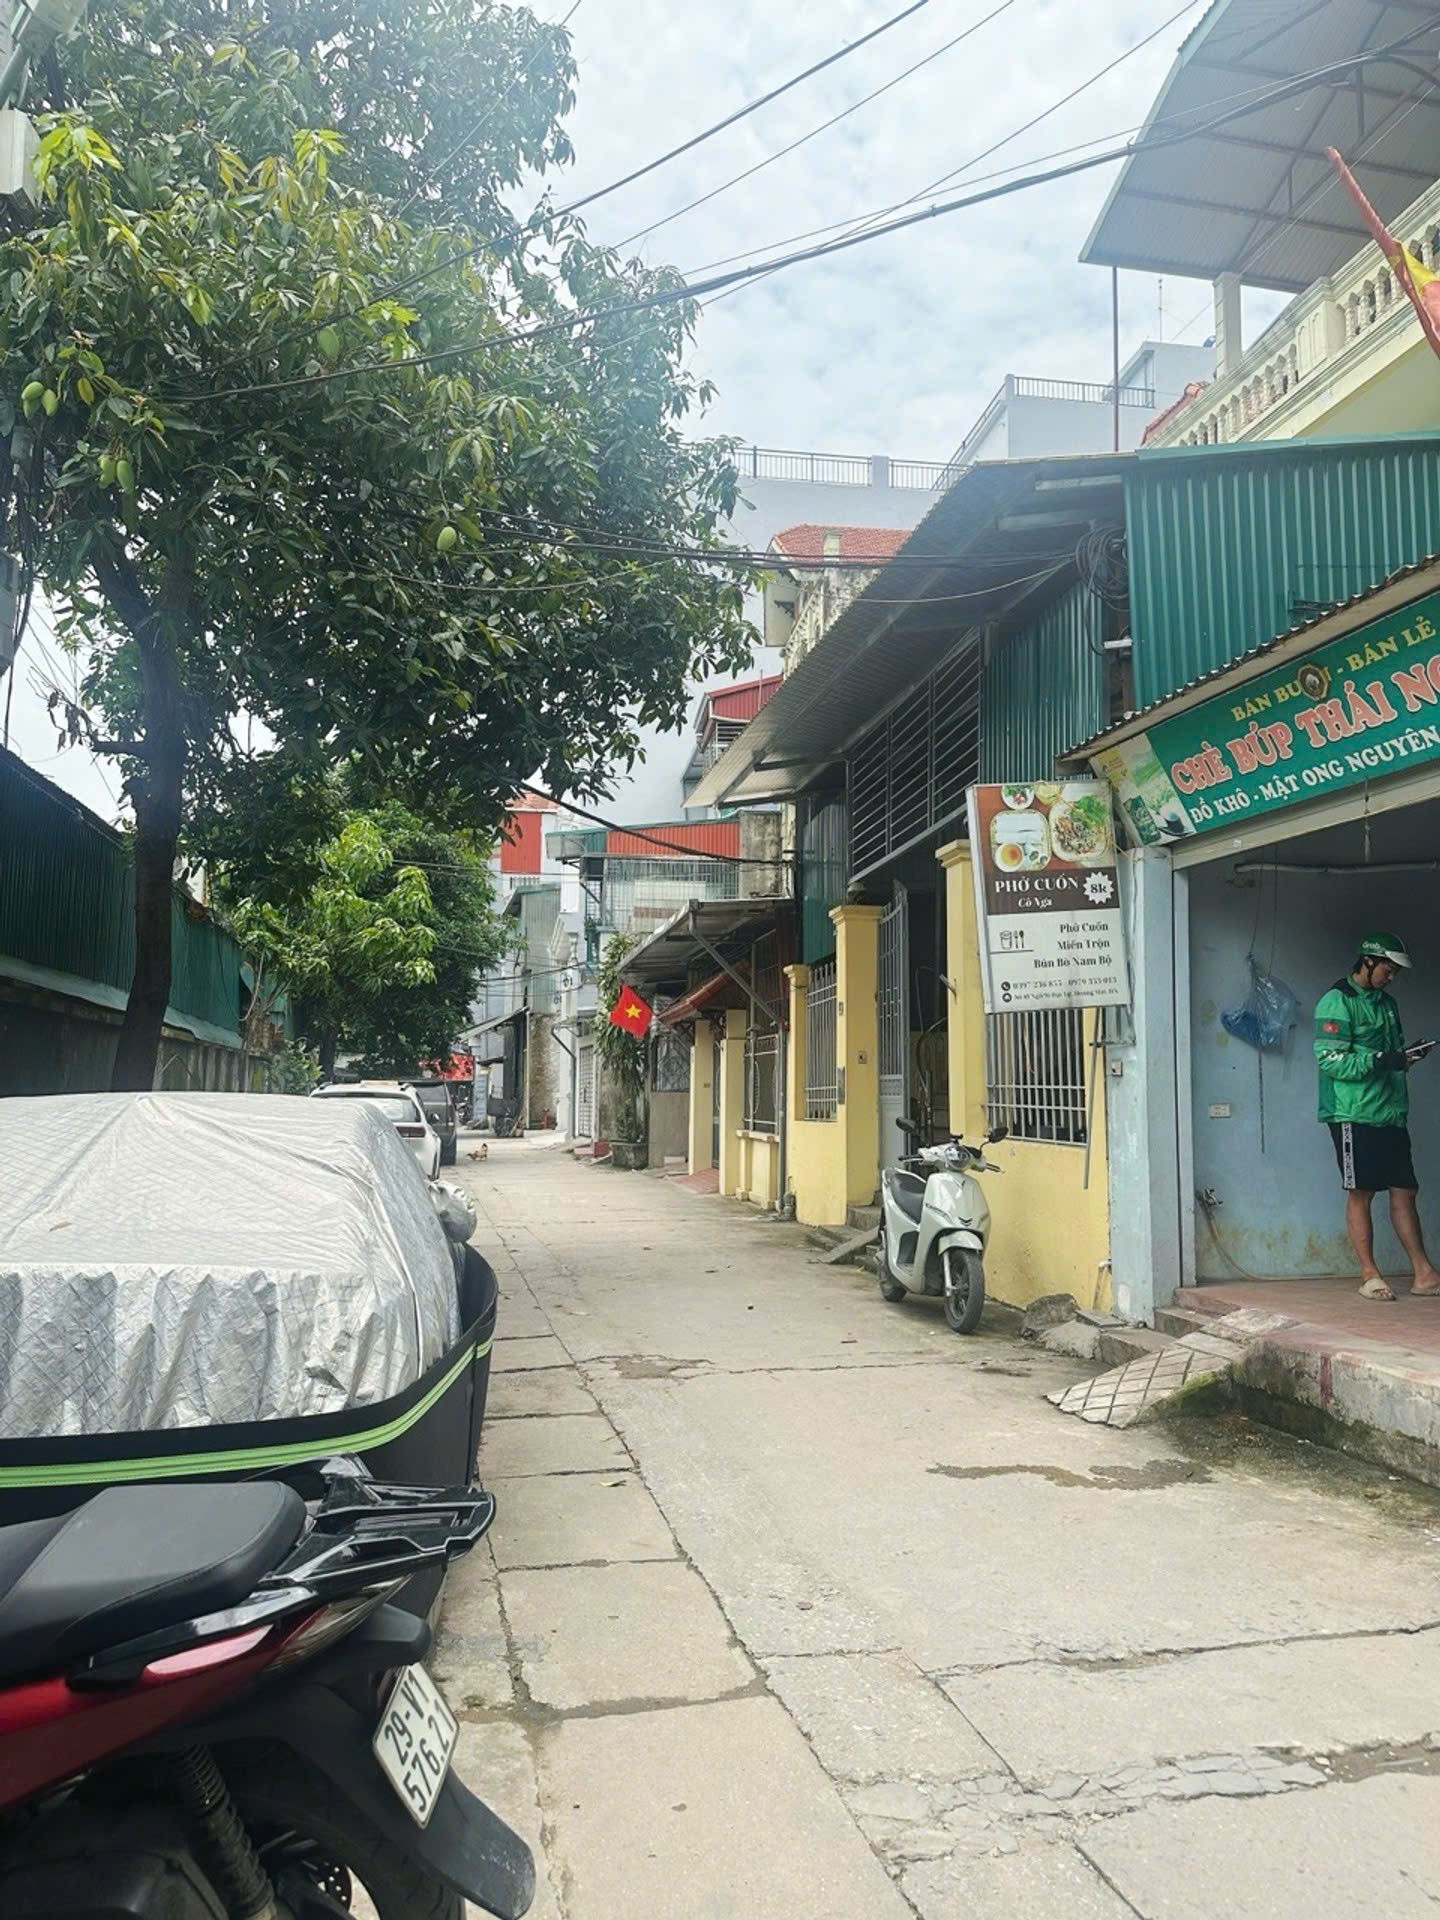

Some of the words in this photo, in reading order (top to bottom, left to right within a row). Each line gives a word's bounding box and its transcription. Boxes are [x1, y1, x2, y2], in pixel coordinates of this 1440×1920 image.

[1231, 694, 1272, 721] BÁN
[1345, 637, 1399, 672] BÁN
[1401, 615, 1436, 646] LẺ
[1171, 741, 1233, 795] CHÈ
[1226, 721, 1293, 775] BÚP
[1295, 680, 1398, 748] THÁI
[1213, 788, 1250, 815] KHÔ
[1259, 774, 1300, 802] MẬT
[1302, 760, 1344, 786] ONG
[1344, 725, 1440, 772] NGUYÊN
[995, 876, 1031, 893] PHỞ
[1034, 873, 1080, 891] CUỐN
[1034, 896, 1053, 909] Nga
[1090, 883, 1107, 894] 8k
[385, 1669, 430, 1767] 29-V1
[403, 1699, 455, 1814] 576.21
